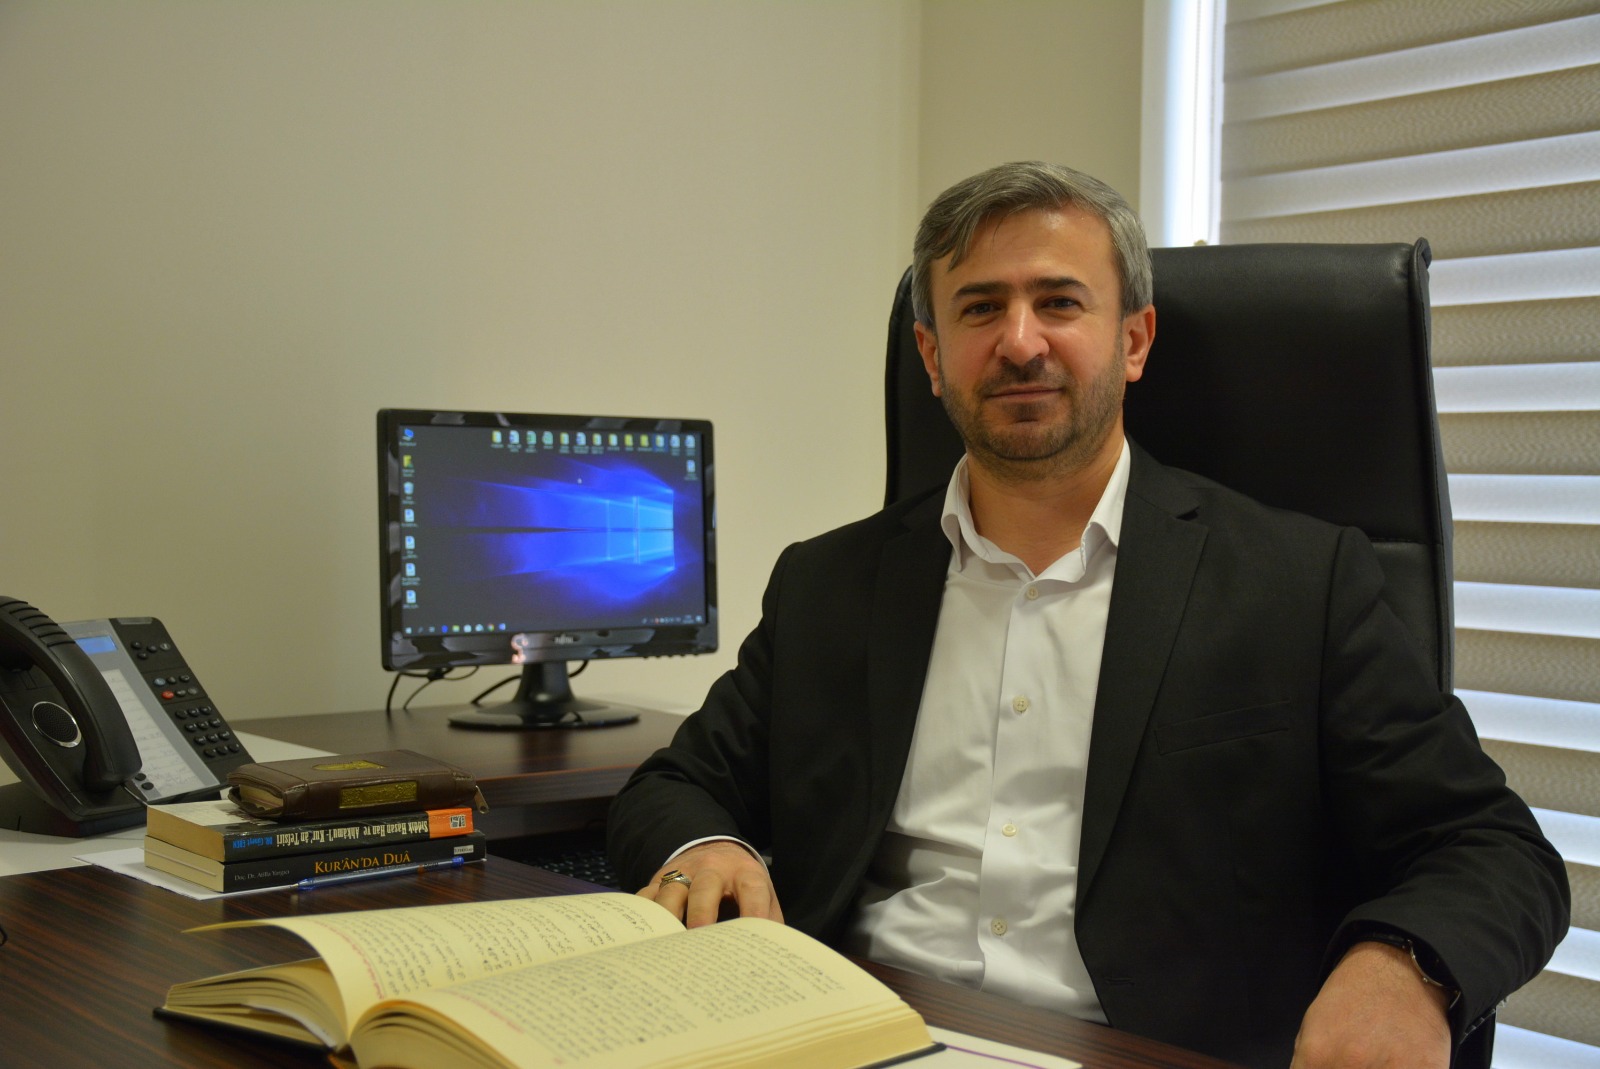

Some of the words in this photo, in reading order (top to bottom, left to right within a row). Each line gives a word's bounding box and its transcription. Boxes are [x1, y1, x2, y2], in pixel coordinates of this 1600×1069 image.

[363, 826, 372, 837] ve
[372, 824, 386, 838] Han
[386, 822, 407, 836] Hasan
[276, 832, 299, 847] Tefsiri
[383, 850, 411, 865] DUÂ
